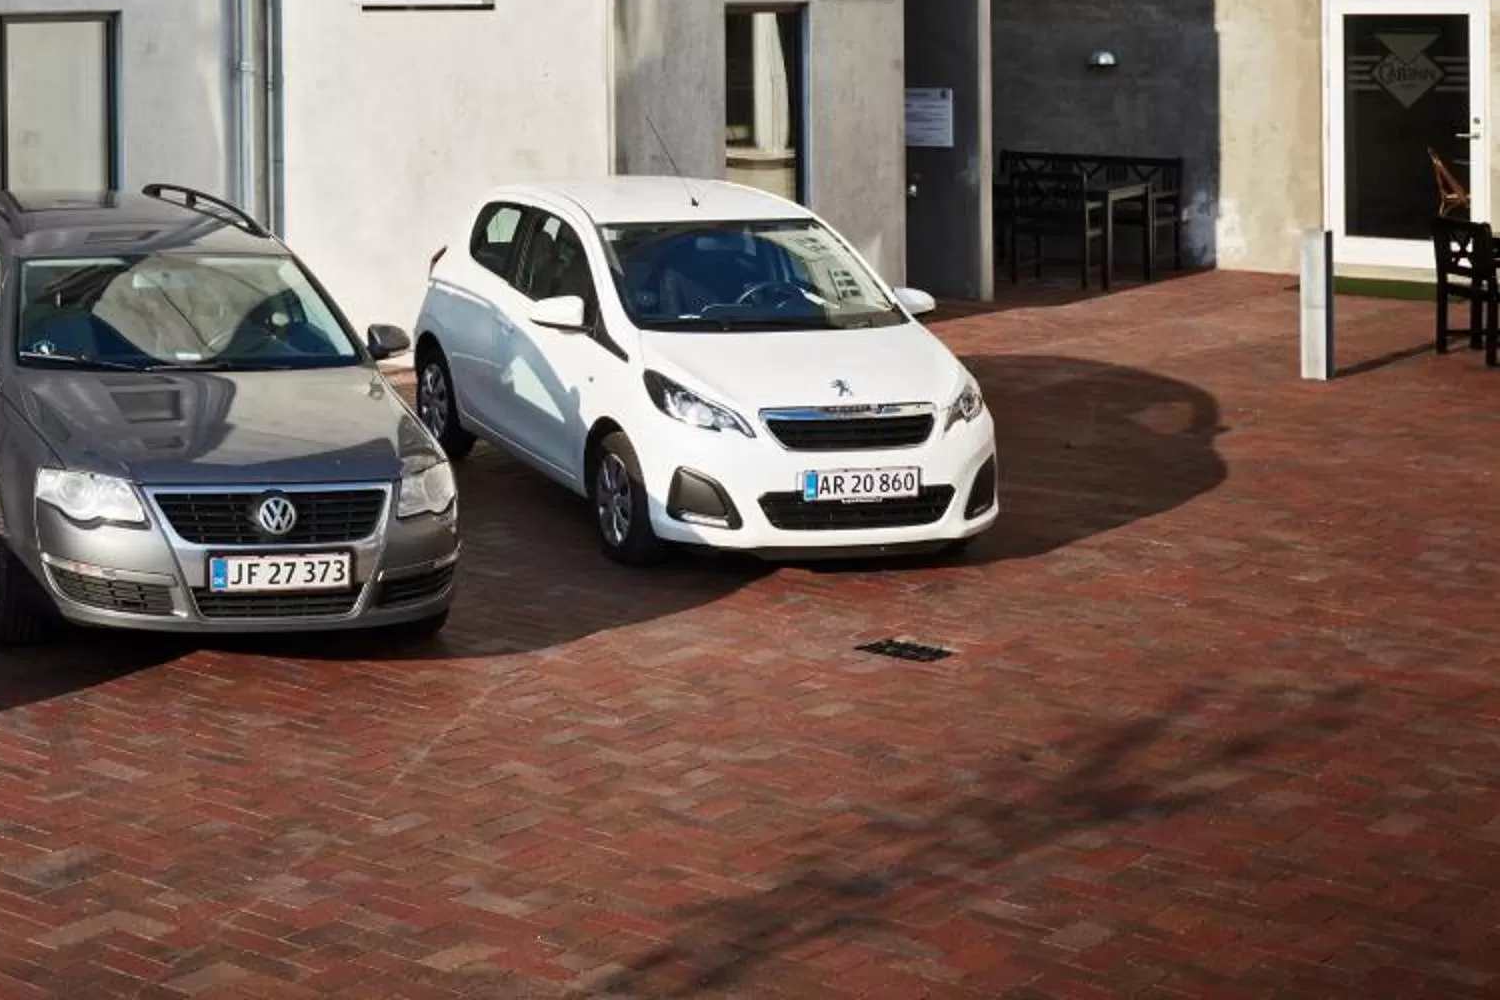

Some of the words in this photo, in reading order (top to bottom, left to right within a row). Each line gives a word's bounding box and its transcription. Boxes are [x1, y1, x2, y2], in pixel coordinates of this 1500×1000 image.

[819, 475, 845, 494] AR
[851, 474, 874, 493] 20
[879, 471, 915, 491] 860
[230, 563, 261, 585] JF
[268, 562, 297, 584] 27
[303, 560, 345, 583] 373
